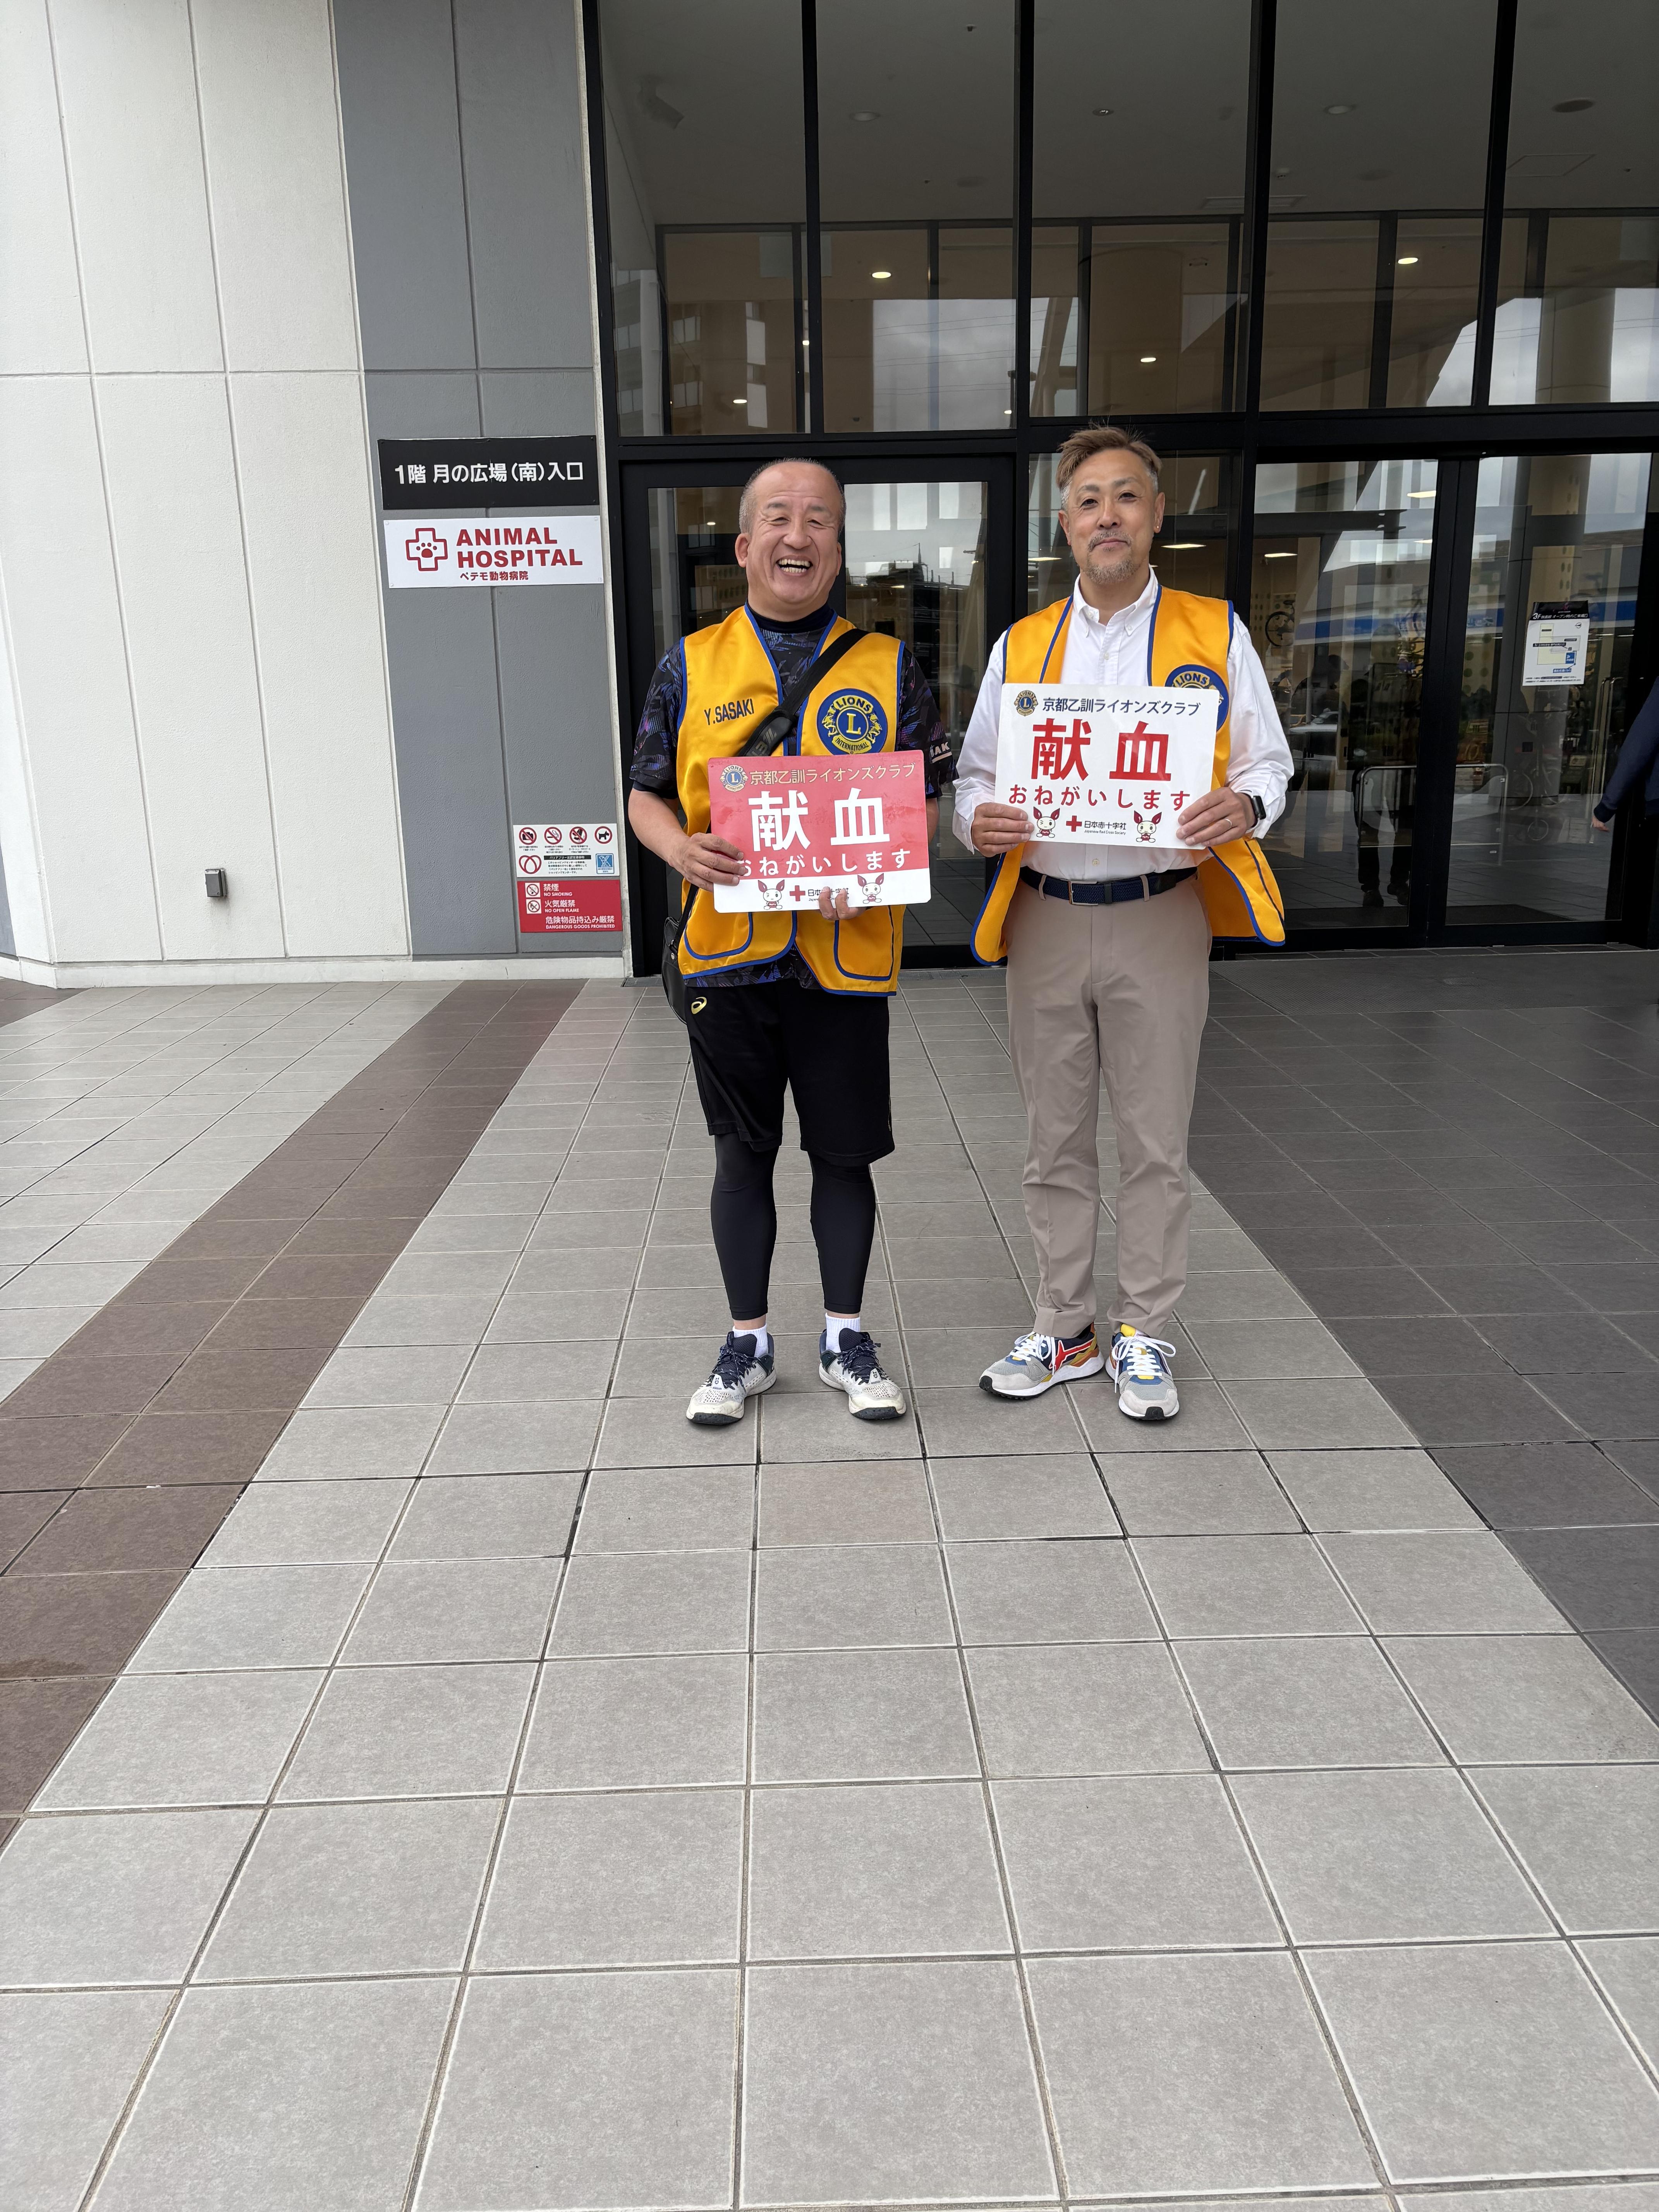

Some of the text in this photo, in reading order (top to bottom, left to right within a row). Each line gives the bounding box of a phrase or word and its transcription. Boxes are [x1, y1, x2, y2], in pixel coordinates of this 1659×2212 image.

[394, 464, 426, 484] 1階
[456, 527, 557, 546] ANIMAL
[457, 549, 583, 568] HOSPITAL
[460, 571, 529, 581] ペテモ動物病院
[1175, 673, 1208, 686] LIONS
[704, 698, 754, 725] Y.SASAKI
[836, 697, 871, 712] LIONS
[1042, 697, 1201, 716] 京都乙訓ライオンズクラブ
[846, 713, 861, 735] L
[835, 737, 869, 751] INTERNATIONAL
[731, 773, 739, 783] L
[749, 762, 916, 786] 京都乙訓ライオンズクラブ
[1008, 784, 1190, 811] おねがいします
[1084, 821, 1127, 830] 日本赤十字社
[543, 883, 559, 891] 禁煙
[545, 900, 575, 908] 火気厳禁
[546, 915, 615, 924] 危険物品持込み厳禁
